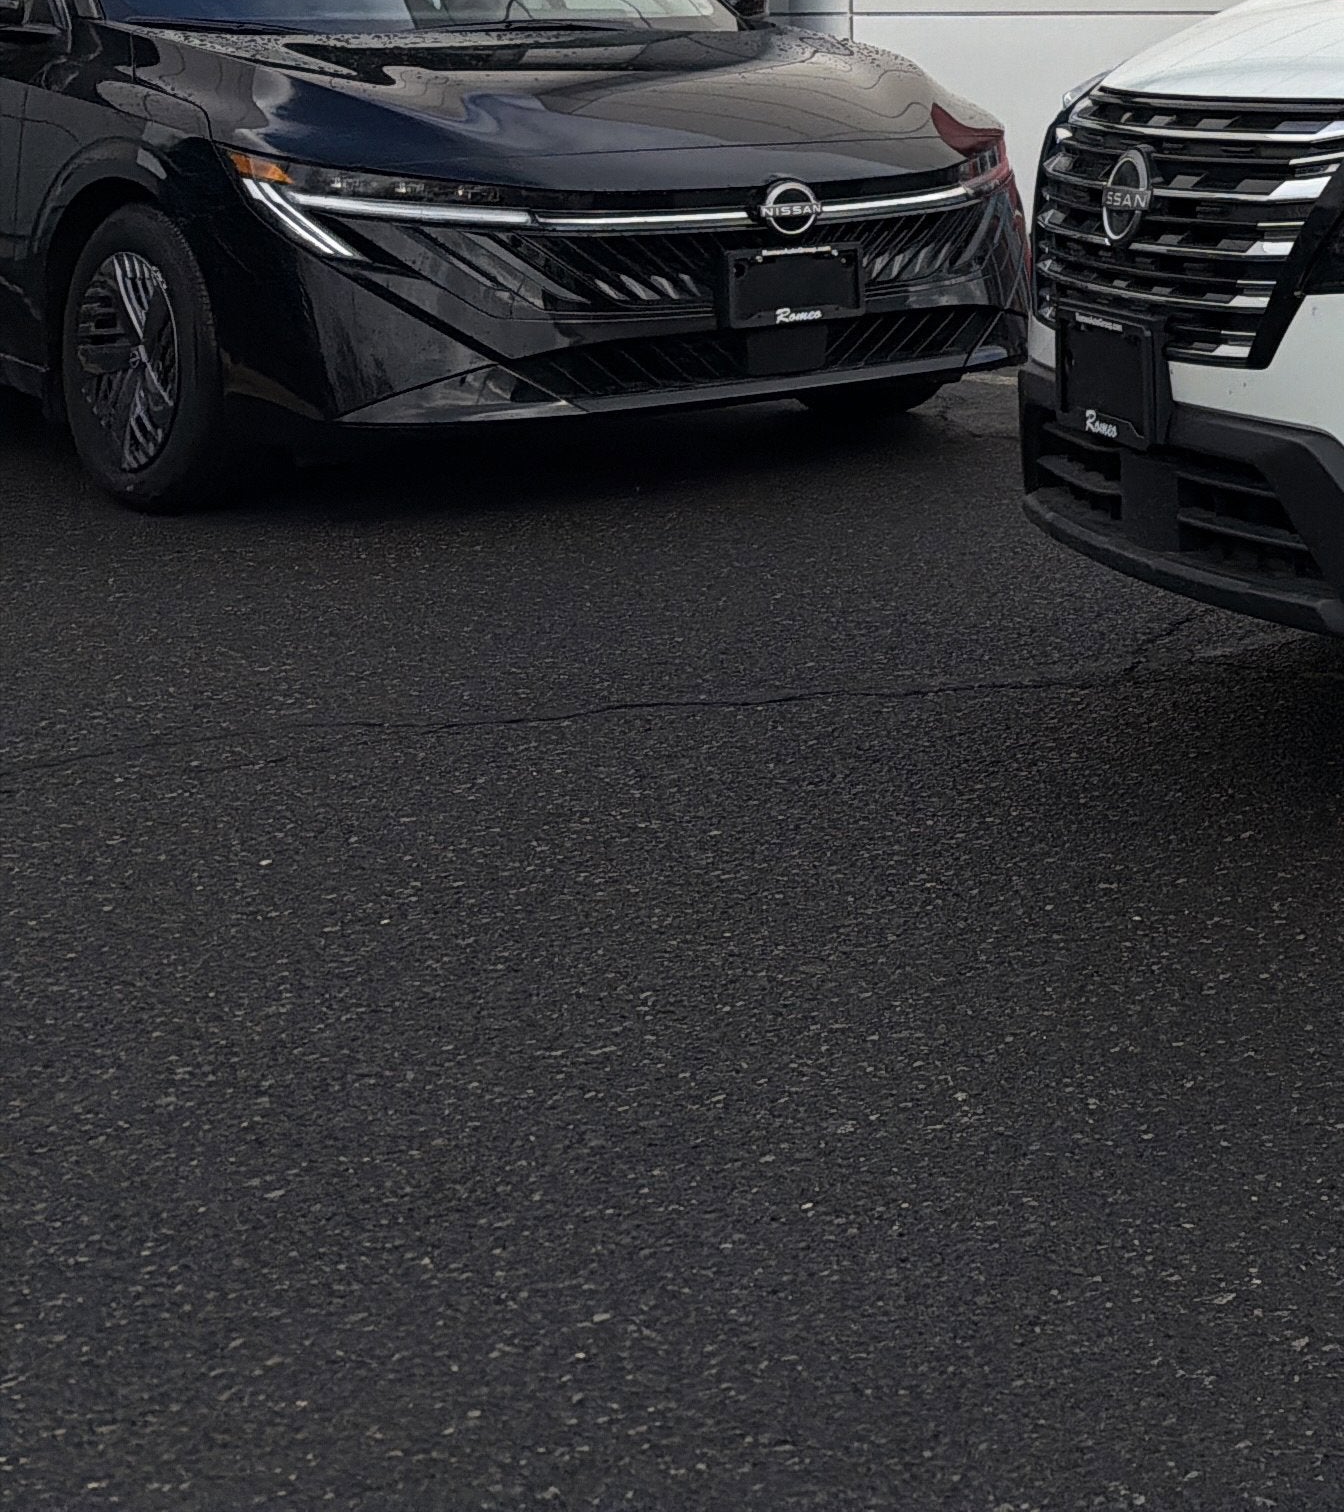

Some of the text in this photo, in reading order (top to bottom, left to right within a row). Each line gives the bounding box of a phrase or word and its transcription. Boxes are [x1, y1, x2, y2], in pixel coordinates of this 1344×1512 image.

[1104, 191, 1149, 208] SSAN
[760, 204, 821, 218] NISSAN
[775, 307, 822, 325] Romeo
[1085, 408, 1118, 439] Romeo
